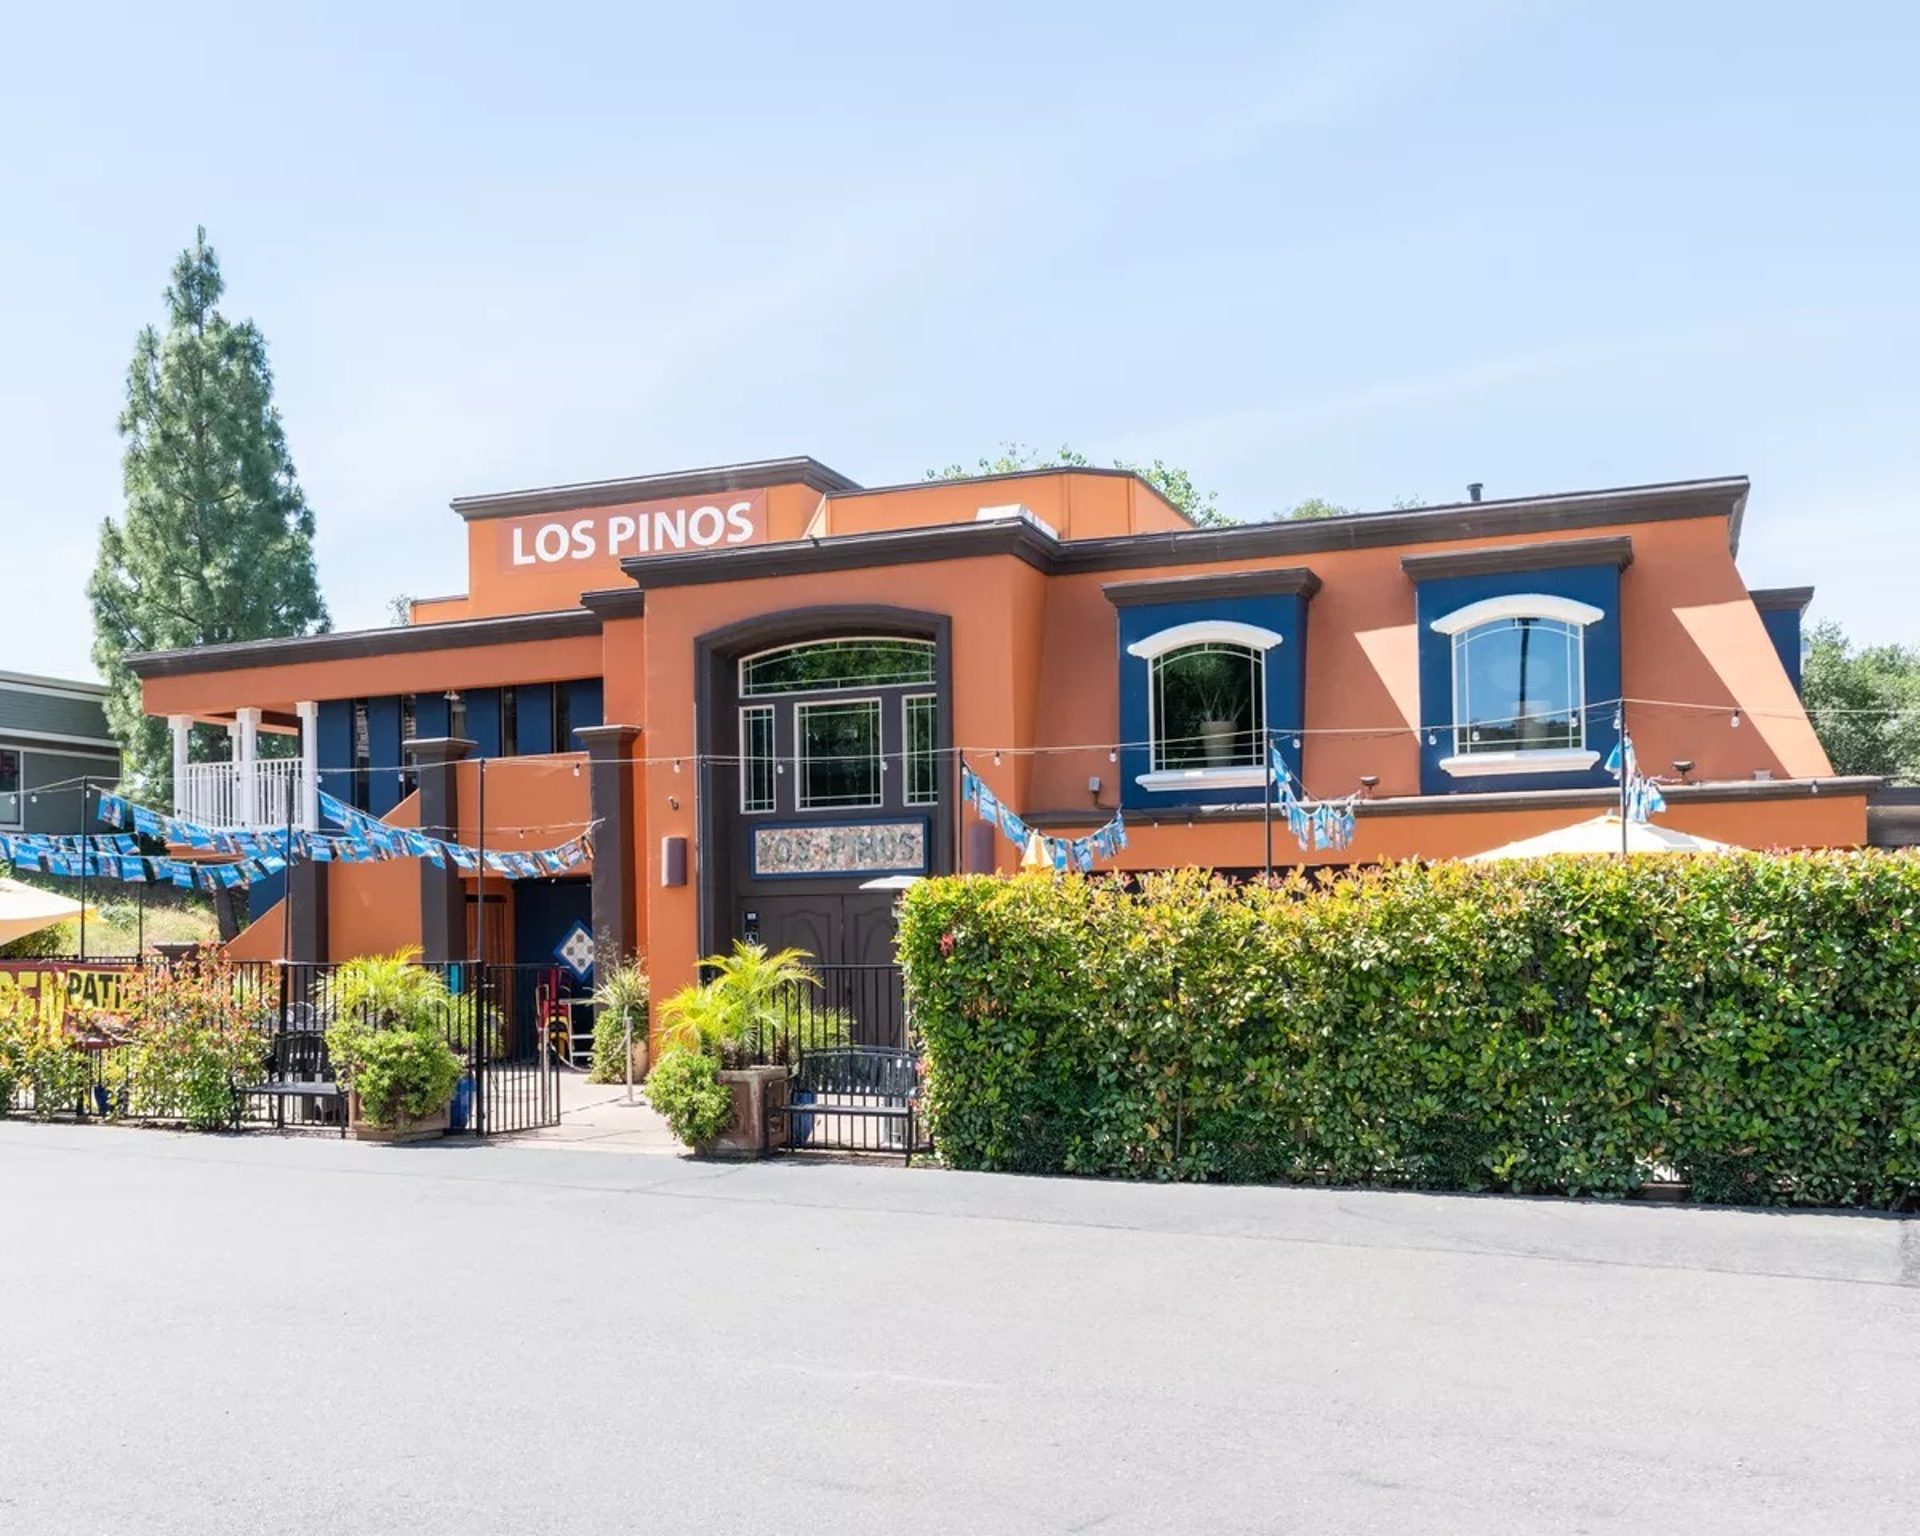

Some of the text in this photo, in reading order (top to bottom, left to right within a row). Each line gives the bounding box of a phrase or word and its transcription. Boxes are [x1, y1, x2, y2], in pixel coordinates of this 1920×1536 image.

[513, 502, 755, 566] LOS PINOS
[67, 971, 130, 1009] PATI
